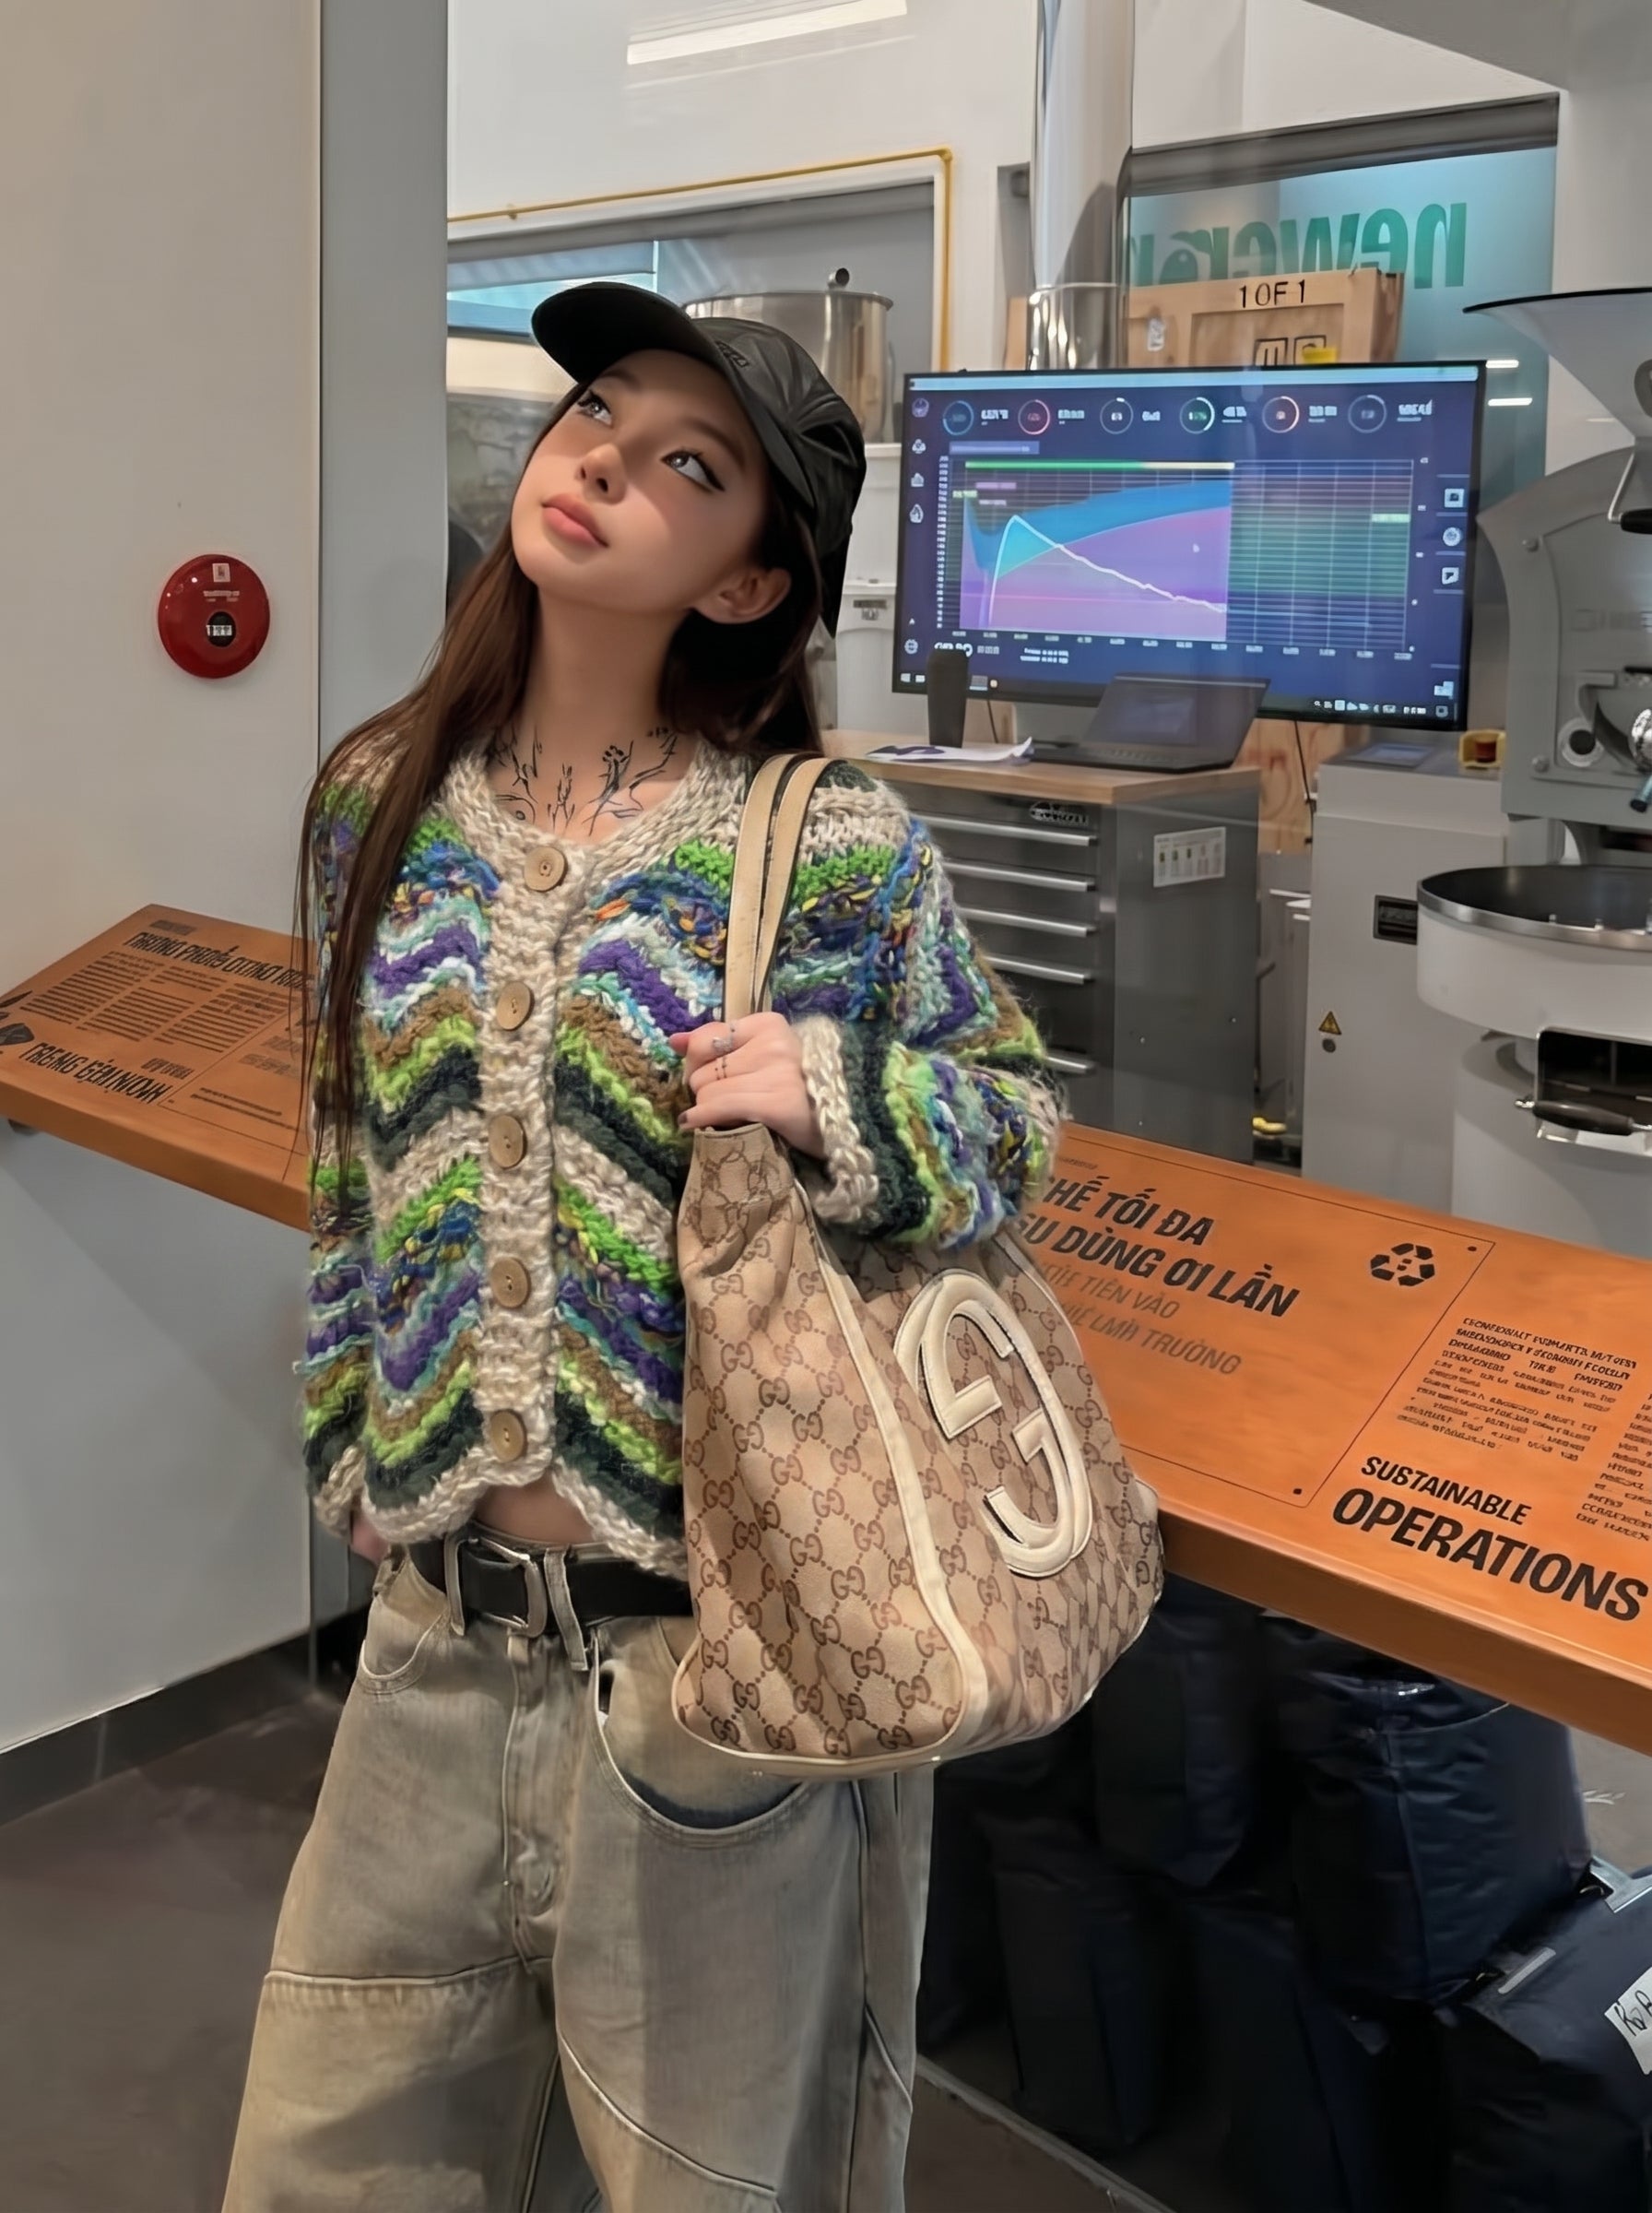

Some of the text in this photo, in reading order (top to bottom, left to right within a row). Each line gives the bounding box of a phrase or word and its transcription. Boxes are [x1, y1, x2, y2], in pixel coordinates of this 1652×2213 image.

[1043, 1176, 1110, 1212] HẾ
[1154, 1209, 1214, 1246] ĐA
[1361, 1456, 1532, 1526] SUSTAINABLE
[1333, 1487, 1650, 1621] OPERATIONS
